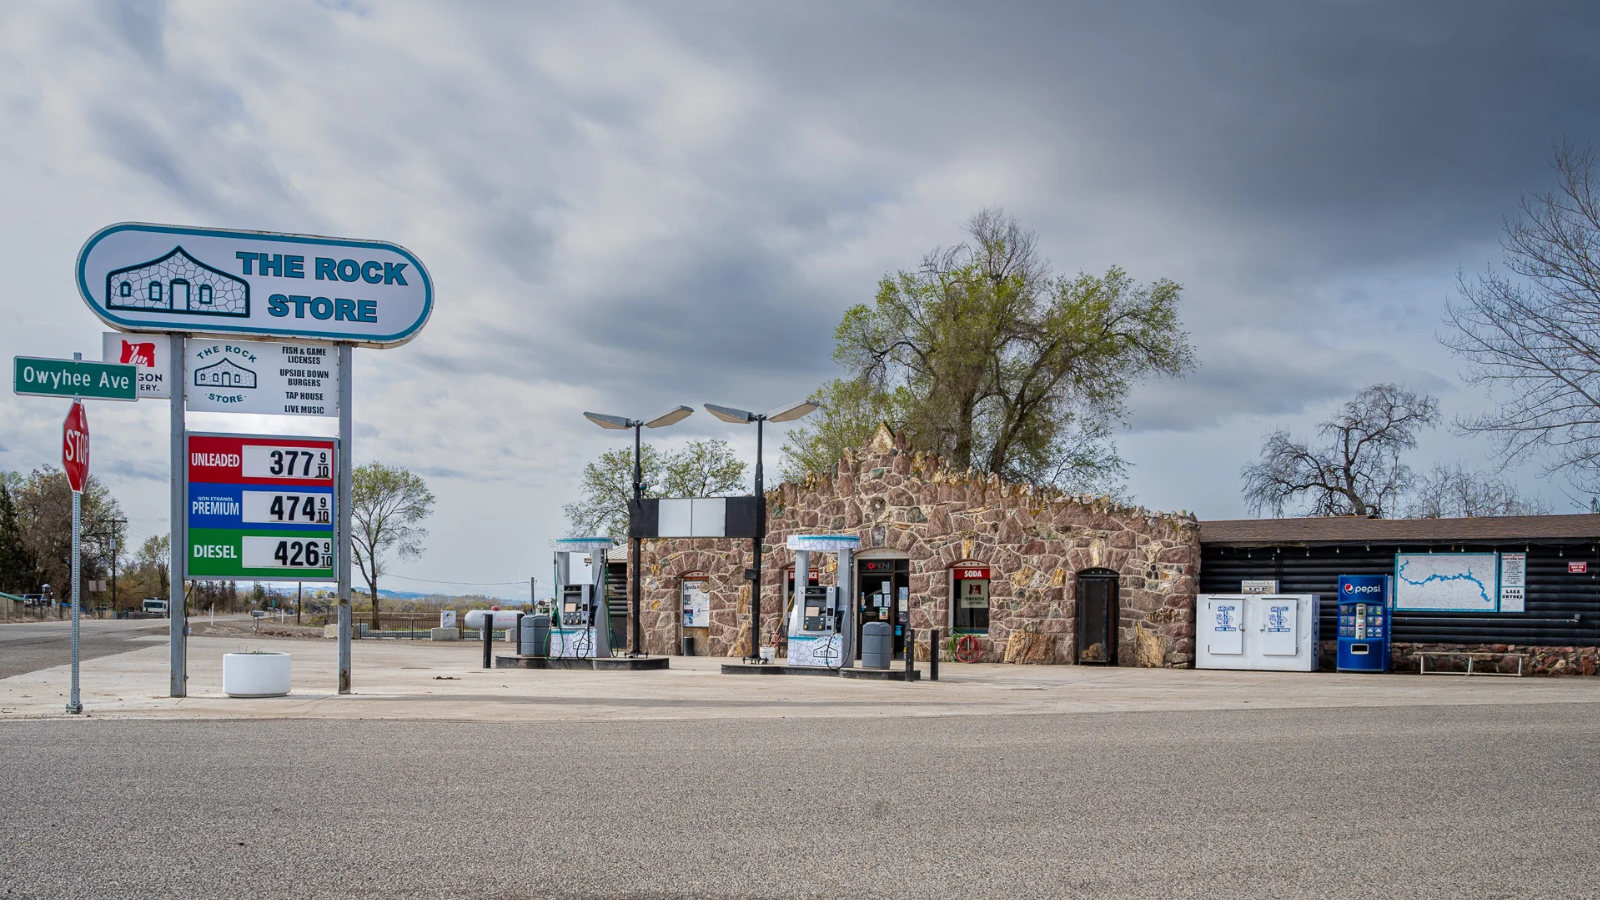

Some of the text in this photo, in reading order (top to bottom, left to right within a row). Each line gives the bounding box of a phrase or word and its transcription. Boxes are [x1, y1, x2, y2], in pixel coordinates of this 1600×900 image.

[236, 251, 409, 286] THE ROCK
[267, 294, 378, 323] STORE
[197, 345, 257, 364] THE ROCK
[282, 346, 298, 355] FISH
[306, 347, 326, 356] GAME
[288, 356, 321, 365] LICENSES
[24, 366, 129, 389] Owyhee Ave
[280, 369, 329, 379] UPSIDE DOWN
[288, 378, 321, 387] BURGERS
[208, 393, 244, 404] STORE
[285, 391, 324, 401] TAP HOUSE
[284, 405, 324, 414] LIVE MUSIC
[66, 429, 89, 466] STOP
[191, 453, 239, 467] UNLEADED
[270, 450, 314, 476] 377
[192, 501, 239, 516] PREMIUM
[270, 495, 315, 522] 474
[194, 545, 237, 558] DIESEL
[275, 541, 319, 566] 426
[1355, 585, 1381, 594] pepsi
